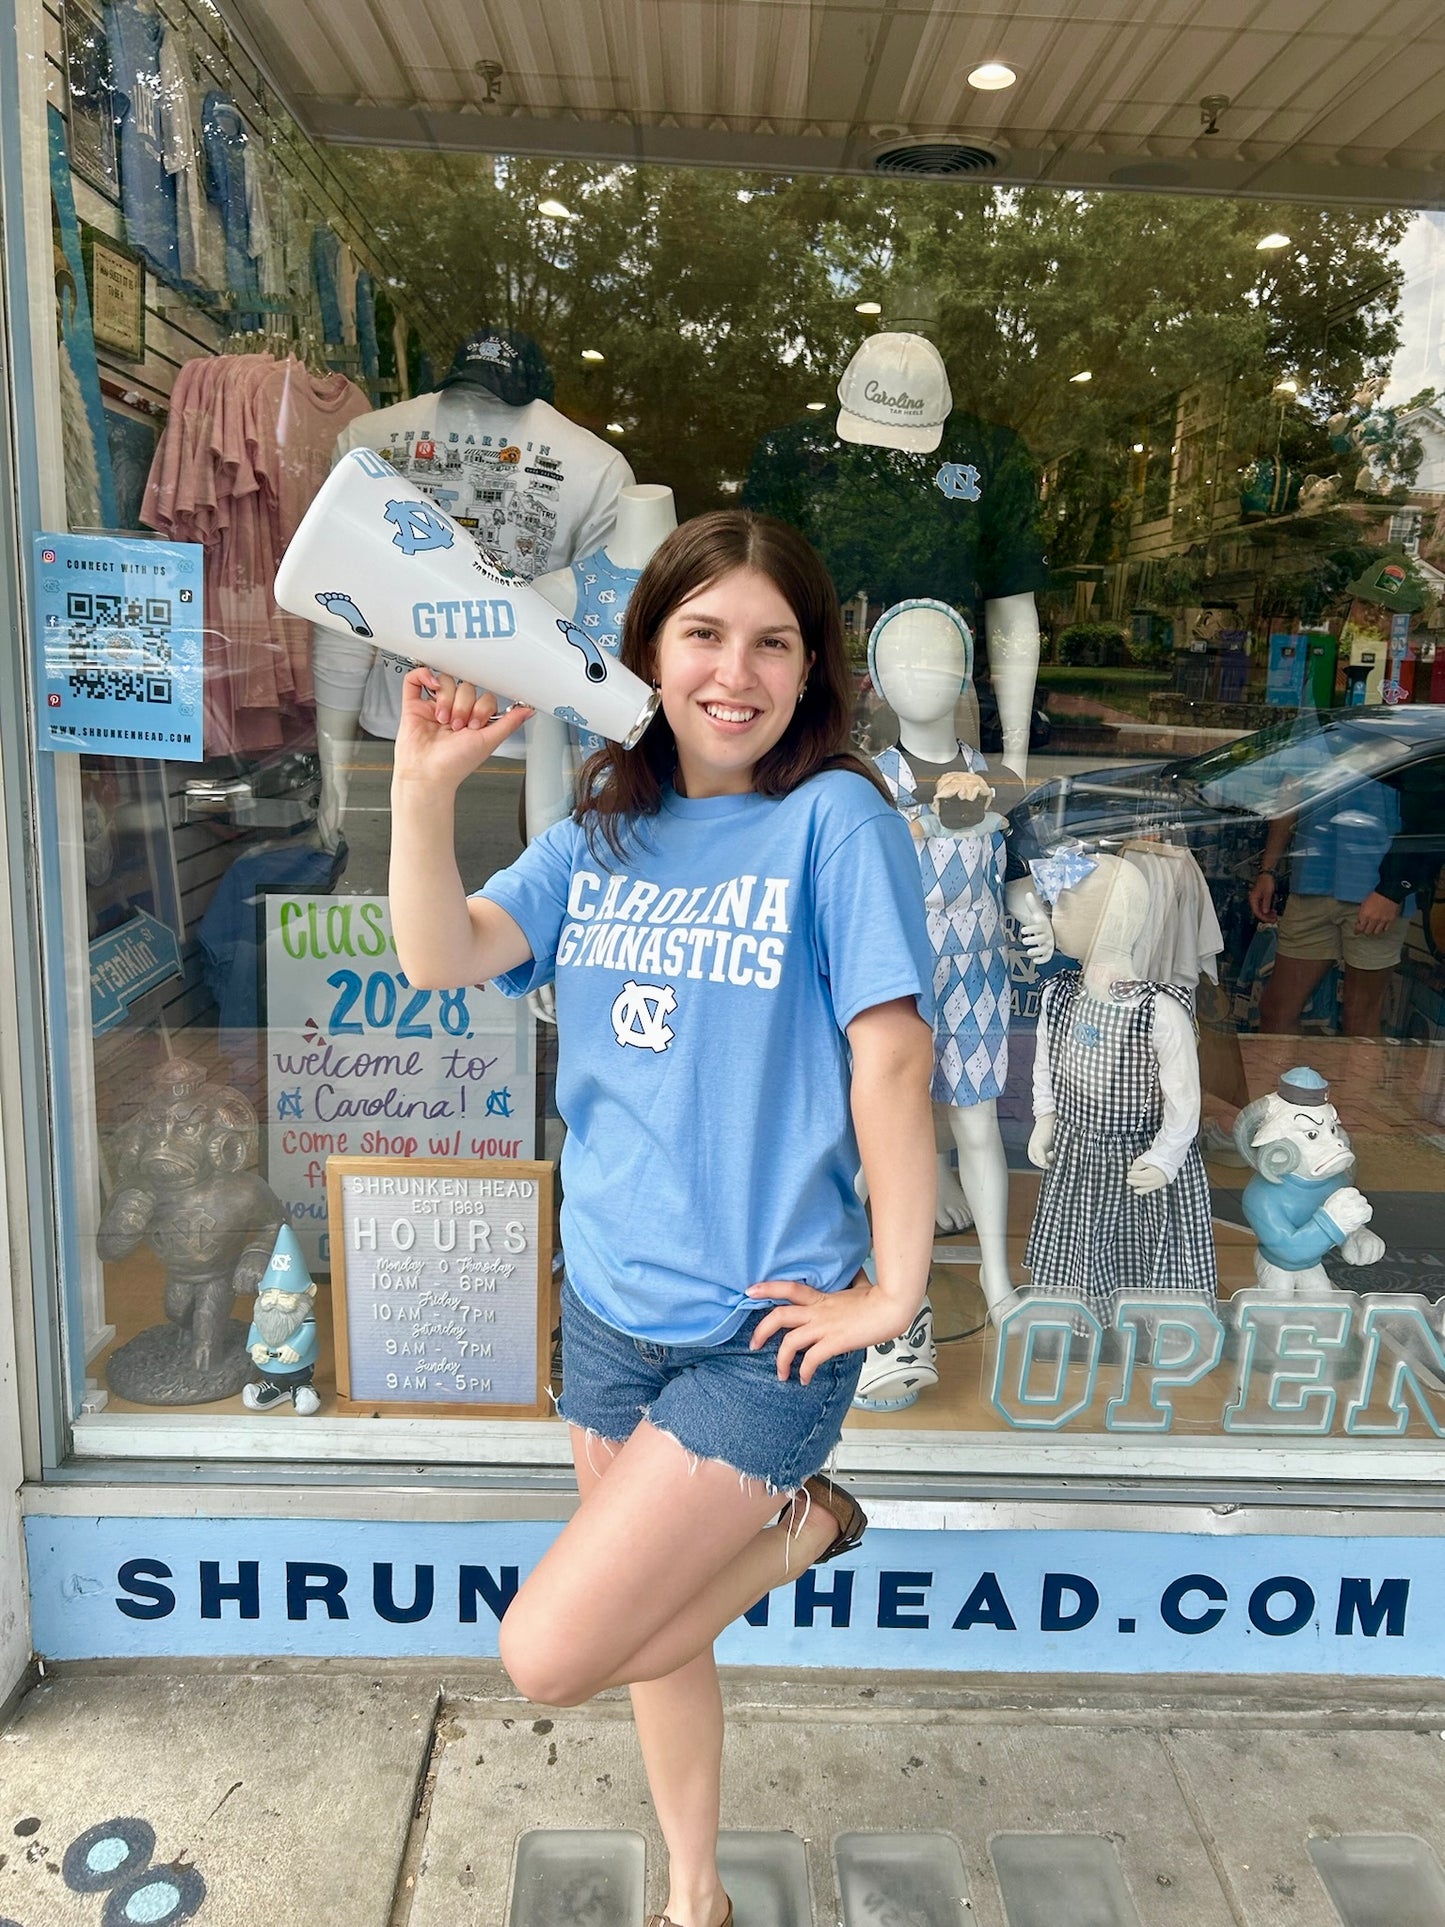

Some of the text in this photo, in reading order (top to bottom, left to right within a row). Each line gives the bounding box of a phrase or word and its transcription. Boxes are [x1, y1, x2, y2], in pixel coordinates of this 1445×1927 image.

[864, 380, 925, 410] Carolina
[390, 431, 430, 442] THE
[449, 432, 508, 447] BARS
[526, 441, 551, 456] IN
[66, 559, 167, 576] CONNECT WITH US
[412, 599, 518, 640] GTHD
[49, 725, 192, 744] WWW.SHRUNKENHEAD.COM
[567, 870, 790, 934] CAROLINA
[555, 922, 784, 990] GYMNASTICS
[273, 1045, 499, 1081] welcome to
[315, 1084, 467, 1123] Carolina!
[281, 1129, 524, 1160] come shop w/ your
[351, 1177, 535, 1198] SHRUNKEN HEAD
[413, 1200, 441, 1215] EST
[353, 1217, 528, 1255] HOURS
[376, 1257, 426, 1275] Monday
[456, 1257, 516, 1279] Thursday
[419, 1291, 462, 1311] Friday
[412, 1321, 467, 1340] Saturday
[415, 1357, 462, 1376] Sunday
[991, 1298, 1445, 1439] OPEN
